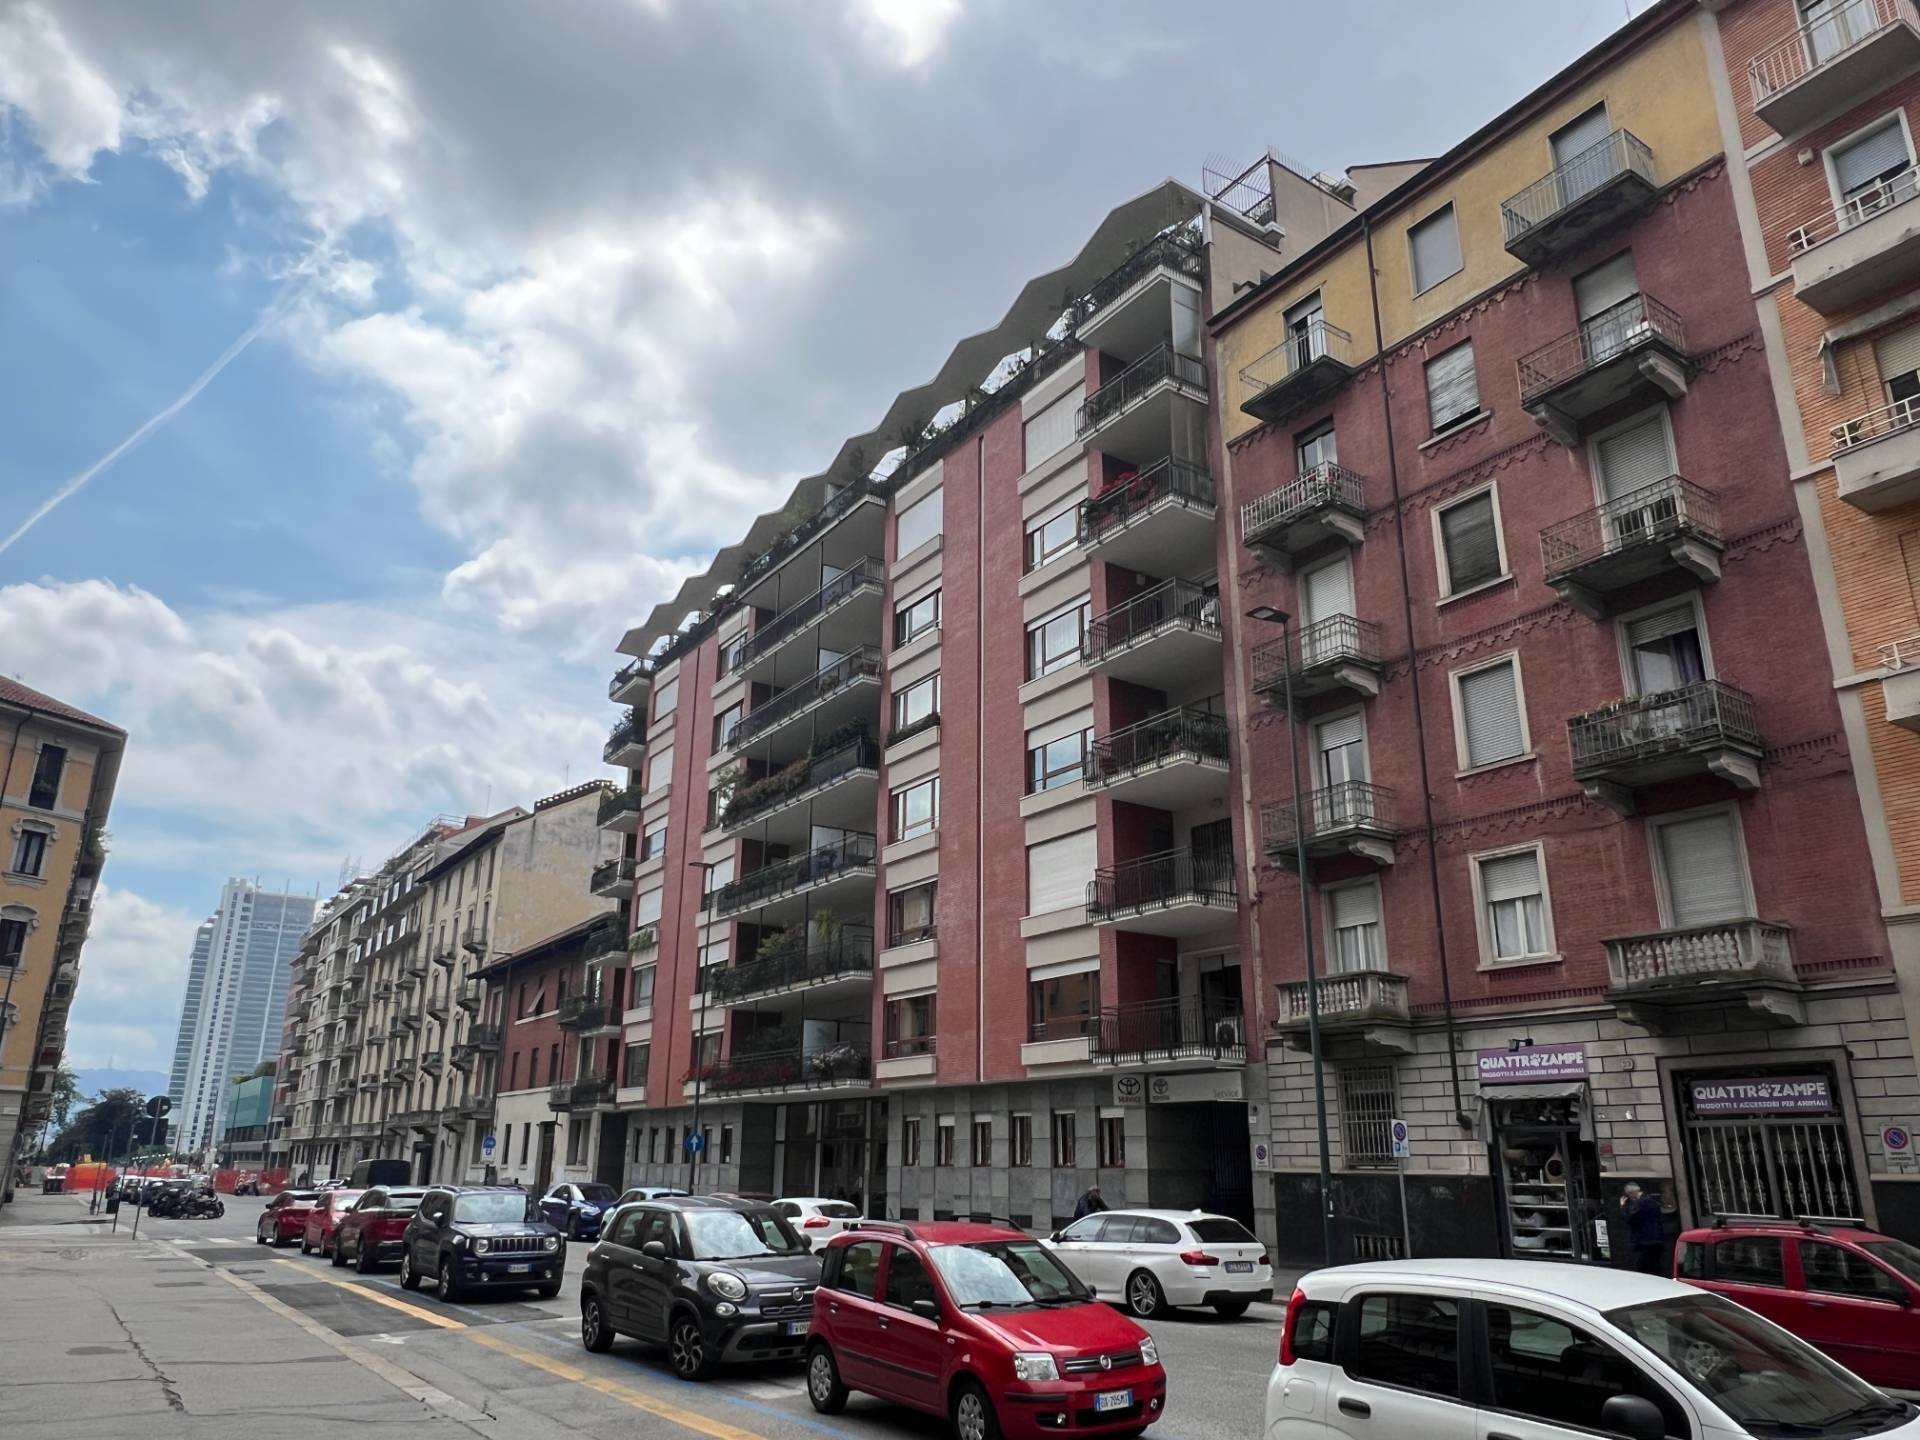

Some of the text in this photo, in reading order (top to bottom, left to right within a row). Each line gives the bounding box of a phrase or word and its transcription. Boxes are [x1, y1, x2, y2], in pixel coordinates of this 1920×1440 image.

[1541, 1052, 1584, 1067] ZAMPE
[1771, 1082, 1826, 1097] ZAMPE
[1798, 1099, 1828, 1107] ANIMALI
